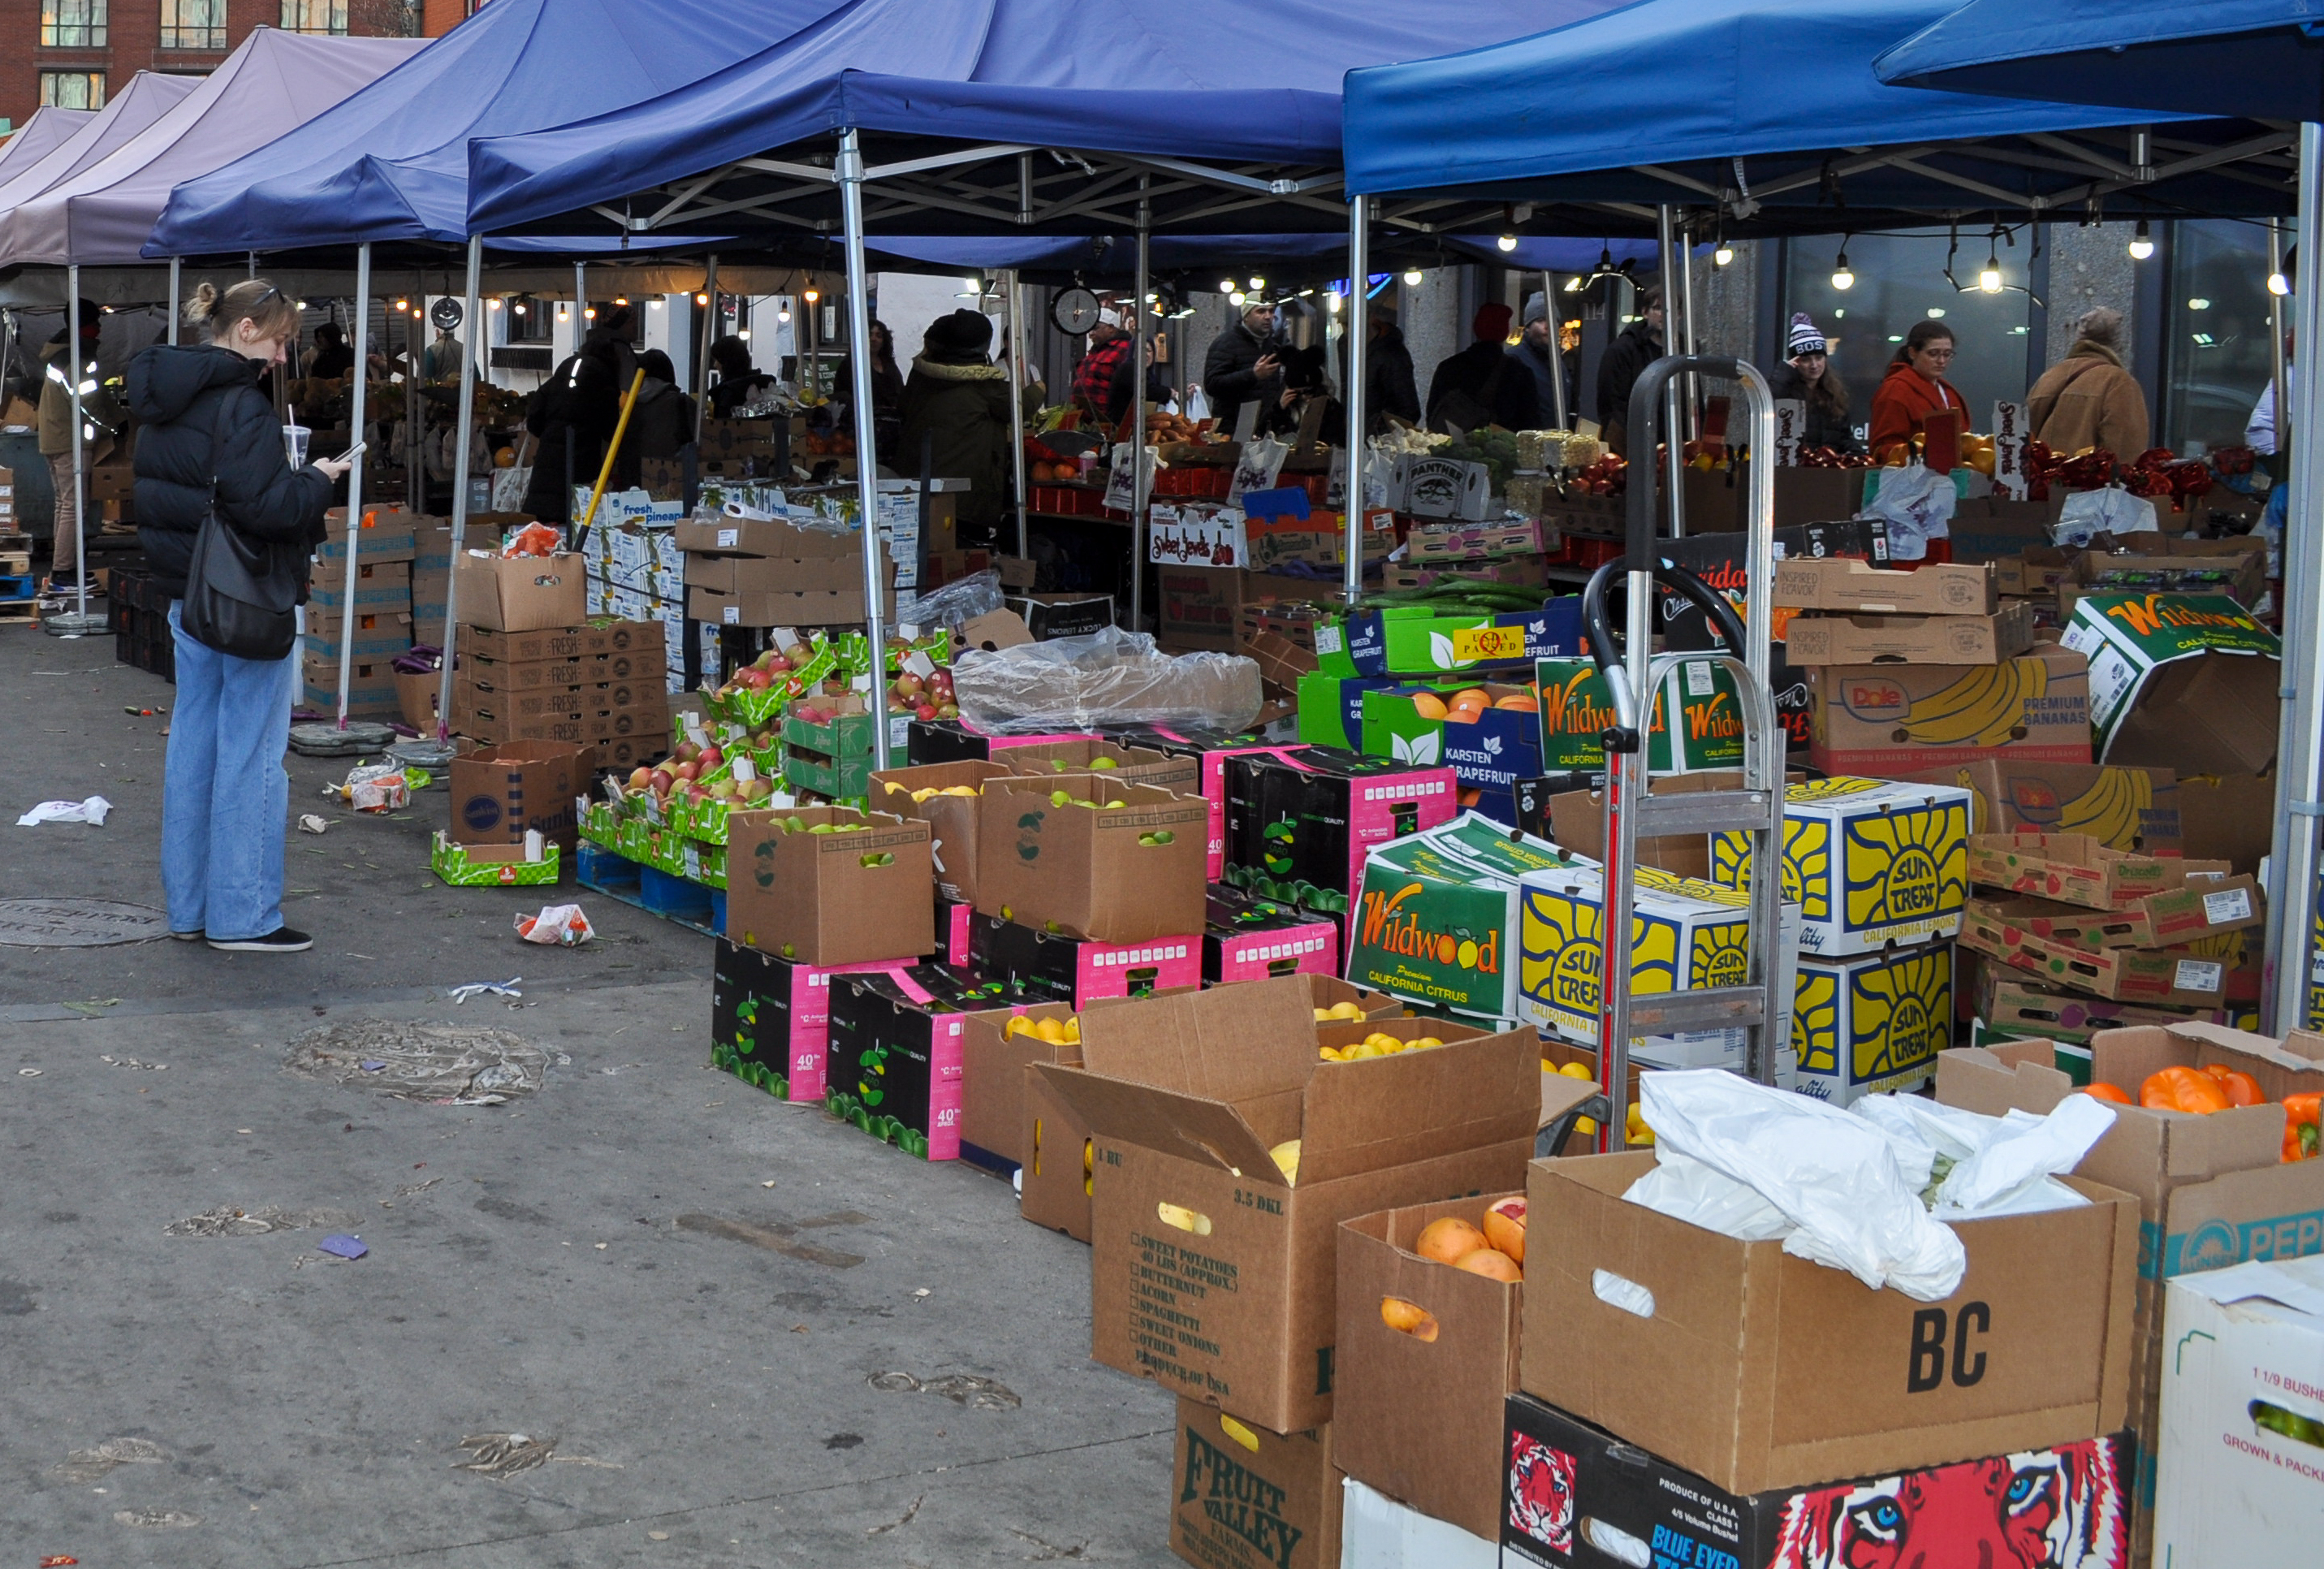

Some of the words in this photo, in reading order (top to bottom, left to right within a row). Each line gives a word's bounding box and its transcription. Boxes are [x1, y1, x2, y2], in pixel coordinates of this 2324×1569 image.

[1998, 401, 2015, 437] Sweet
[1410, 463, 1463, 482] PANTHER
[624, 504, 652, 515] fresh
[646, 511, 684, 525] pineap
[772, 504, 788, 514] fresh
[1152, 534, 1180, 559] Sweet
[1178, 527, 1210, 563] Jewels
[1780, 571, 1818, 584] INSPIRED
[1782, 583, 1816, 597] FLAVOR
[1047, 627, 1077, 636] LEMONS
[1078, 624, 1103, 634] LUCKY
[1472, 633, 1509, 643] USDA
[1791, 631, 1829, 643] INSPIRED
[551, 637, 578, 655] FRESH
[589, 638, 606, 649] FROM
[1350, 638, 1372, 647] KARSTEN
[1464, 642, 1516, 654] PASSED
[1352, 646, 1382, 659] GRAPEFRUIT
[552, 666, 578, 683] FRESH
[589, 666, 606, 677] FROM
[552, 695, 578, 713] FRESH
[590, 695, 606, 707] FROM
[1852, 686, 1901, 706] Dole
[2024, 696, 2084, 711] PREMIUM
[2024, 711, 2087, 725] BANANAS
[553, 724, 579, 741] FRESH
[591, 723, 607, 734] FROM
[1445, 747, 1492, 765] KARSTEN
[1559, 754, 1605, 765] CALIFORNIA
[1837, 754, 1874, 763] PREMIUM
[1874, 753, 1912, 762] BANANAS
[1922, 751, 1959, 761] PREMIUM
[2008, 750, 2044, 759] PREMIUM
[2046, 749, 2084, 759] BANANAS
[1208, 839, 1222, 849] 40
[1890, 882, 1935, 914] TREAT
[1363, 883, 1499, 975] Wildwood
[1863, 919, 1922, 944] CALIFORNIA
[1923, 914, 1956, 934] LEMONS
[1396, 964, 1432, 983] Premium
[1709, 970, 1746, 987] TREAT
[1368, 970, 1424, 994] CALIFORNIA
[1426, 984, 1468, 1004] CITRUS
[1531, 1001, 1587, 1033] CALIFORNIA
[1892, 1028, 1927, 1064] TREAT
[797, 1054, 814, 1066] 40
[1868, 1067, 1916, 1093] CALIFORNIA
[937, 1109, 954, 1122] 40
[1099, 1148, 1103, 1161] 1
[1107, 1150, 1122, 1168] BU
[1234, 1189, 1253, 1208] 3.5
[1257, 1195, 1285, 1217] DKL
[1141, 1236, 1177, 1259] SWEET
[1180, 1243, 1240, 1278] POTATOES
[1140, 1265, 1207, 1299] BUTTERNUT
[1141, 1251, 1155, 1264] 40
[1157, 1256, 1177, 1273] LBS
[1180, 1260, 1239, 1294] (APPROX.)
[1140, 1282, 1177, 1305] ACORN
[1139, 1299, 1201, 1332] SPAGHETTI
[1139, 1316, 1176, 1339] SWEET
[1178, 1331, 1220, 1357] ONIONS
[1139, 1333, 1177, 1358] OTHER
[1907, 1301, 1991, 1394] BC
[1135, 1349, 1188, 1384] PRODUCE
[1189, 1368, 1205, 1385] OF
[1207, 1372, 1230, 1397] USA
[2253, 1367, 2258, 1379] 1
[2262, 1371, 2281, 1386] 1/9
[2222, 1433, 2270, 1462] GROWN
[2273, 1453, 2282, 1466] &
[1180, 1425, 1286, 1517] FRUIT
[1659, 1477, 1699, 1502] PRODUCE
[1700, 1493, 1712, 1506] OF
[1713, 1498, 1740, 1519] U.S.A.
[1671, 1507, 1684, 1520] 4/5
[1683, 1511, 1712, 1533] Volume
[1712, 1524, 1739, 1544] Bushel
[1706, 1510, 1733, 1529] CLASS
[1734, 1520, 1739, 1532] 1
[1203, 1500, 1304, 1569] VALLEY
[1650, 1523, 1695, 1563] BLUE
[1509, 1541, 1544, 1564] DISTRIBUTED
[1544, 1560, 1553, 1569] BY
